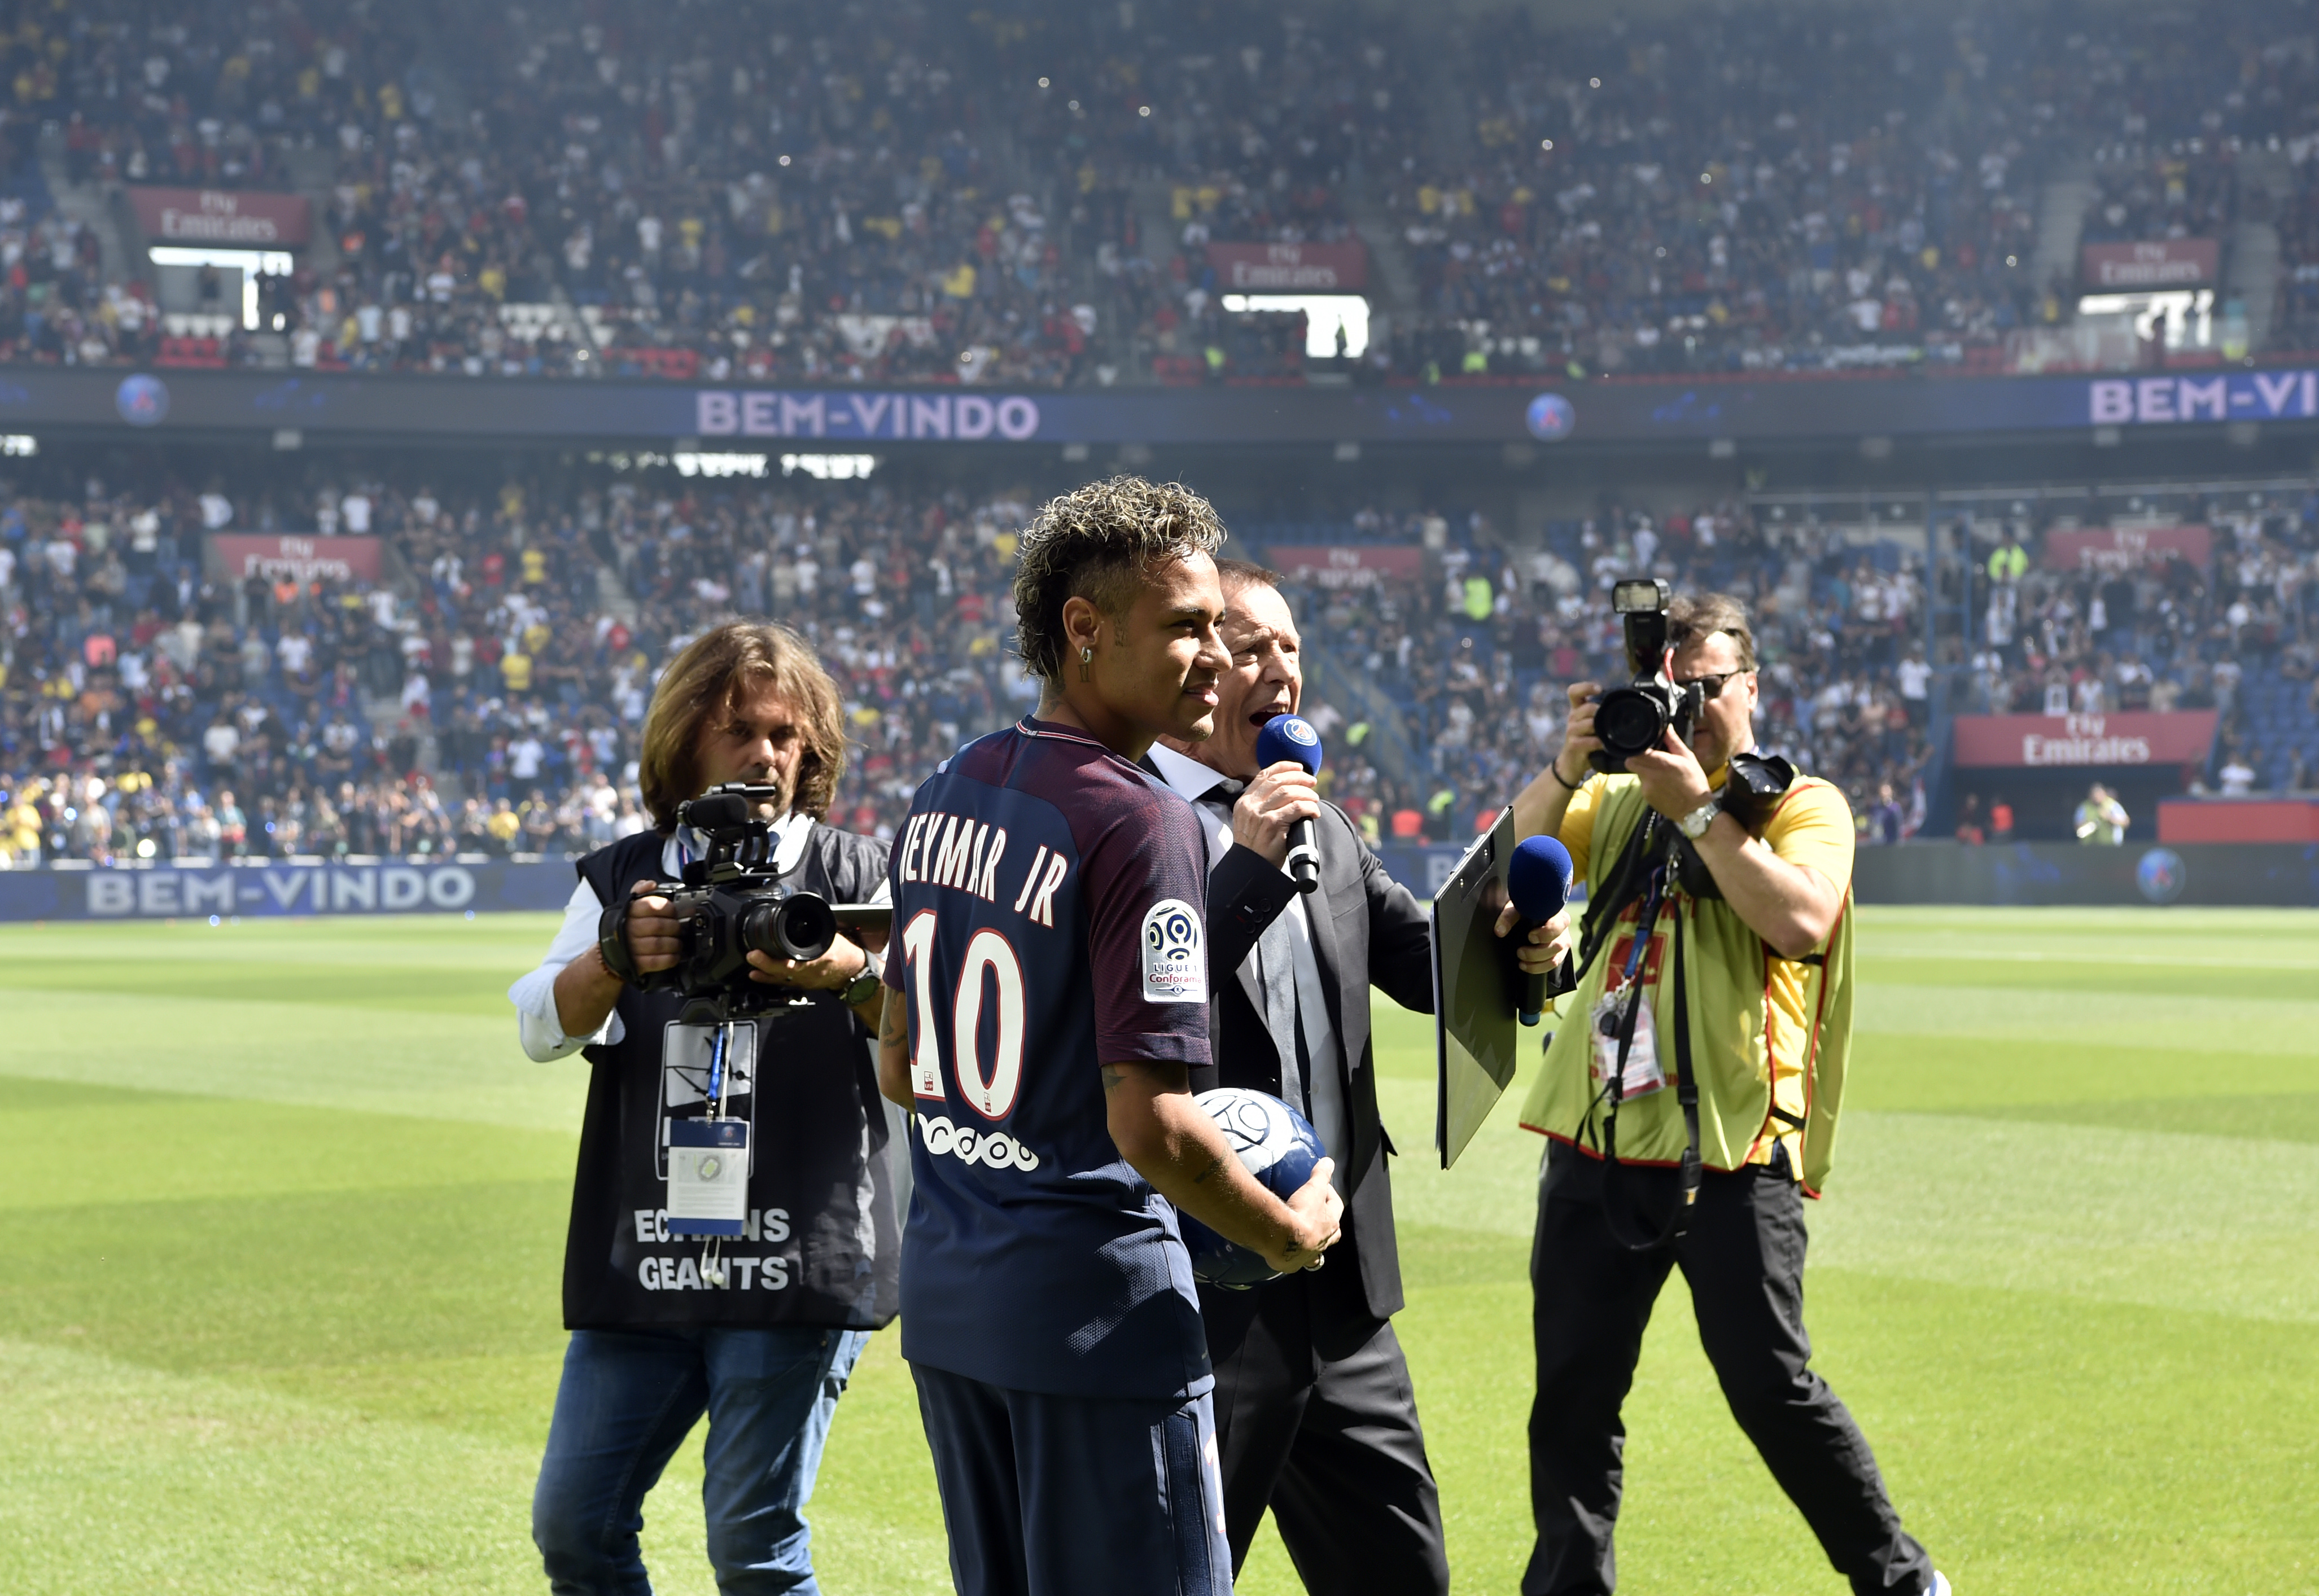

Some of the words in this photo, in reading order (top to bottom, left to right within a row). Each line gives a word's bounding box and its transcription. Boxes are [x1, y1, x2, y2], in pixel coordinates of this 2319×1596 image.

[696, 391, 1039, 440] BEM-VINDO
[2091, 370, 2319, 423] BEM-VI
[2065, 713, 2106, 737] Fly
[2023, 734, 2150, 765] Emirates
[87, 867, 475, 915] BEM-VINDO
[1013, 843, 1069, 928] JR
[1149, 974, 1201, 983] Conforama
[902, 907, 1026, 1121] 10
[638, 1256, 789, 1291] GEANTS
